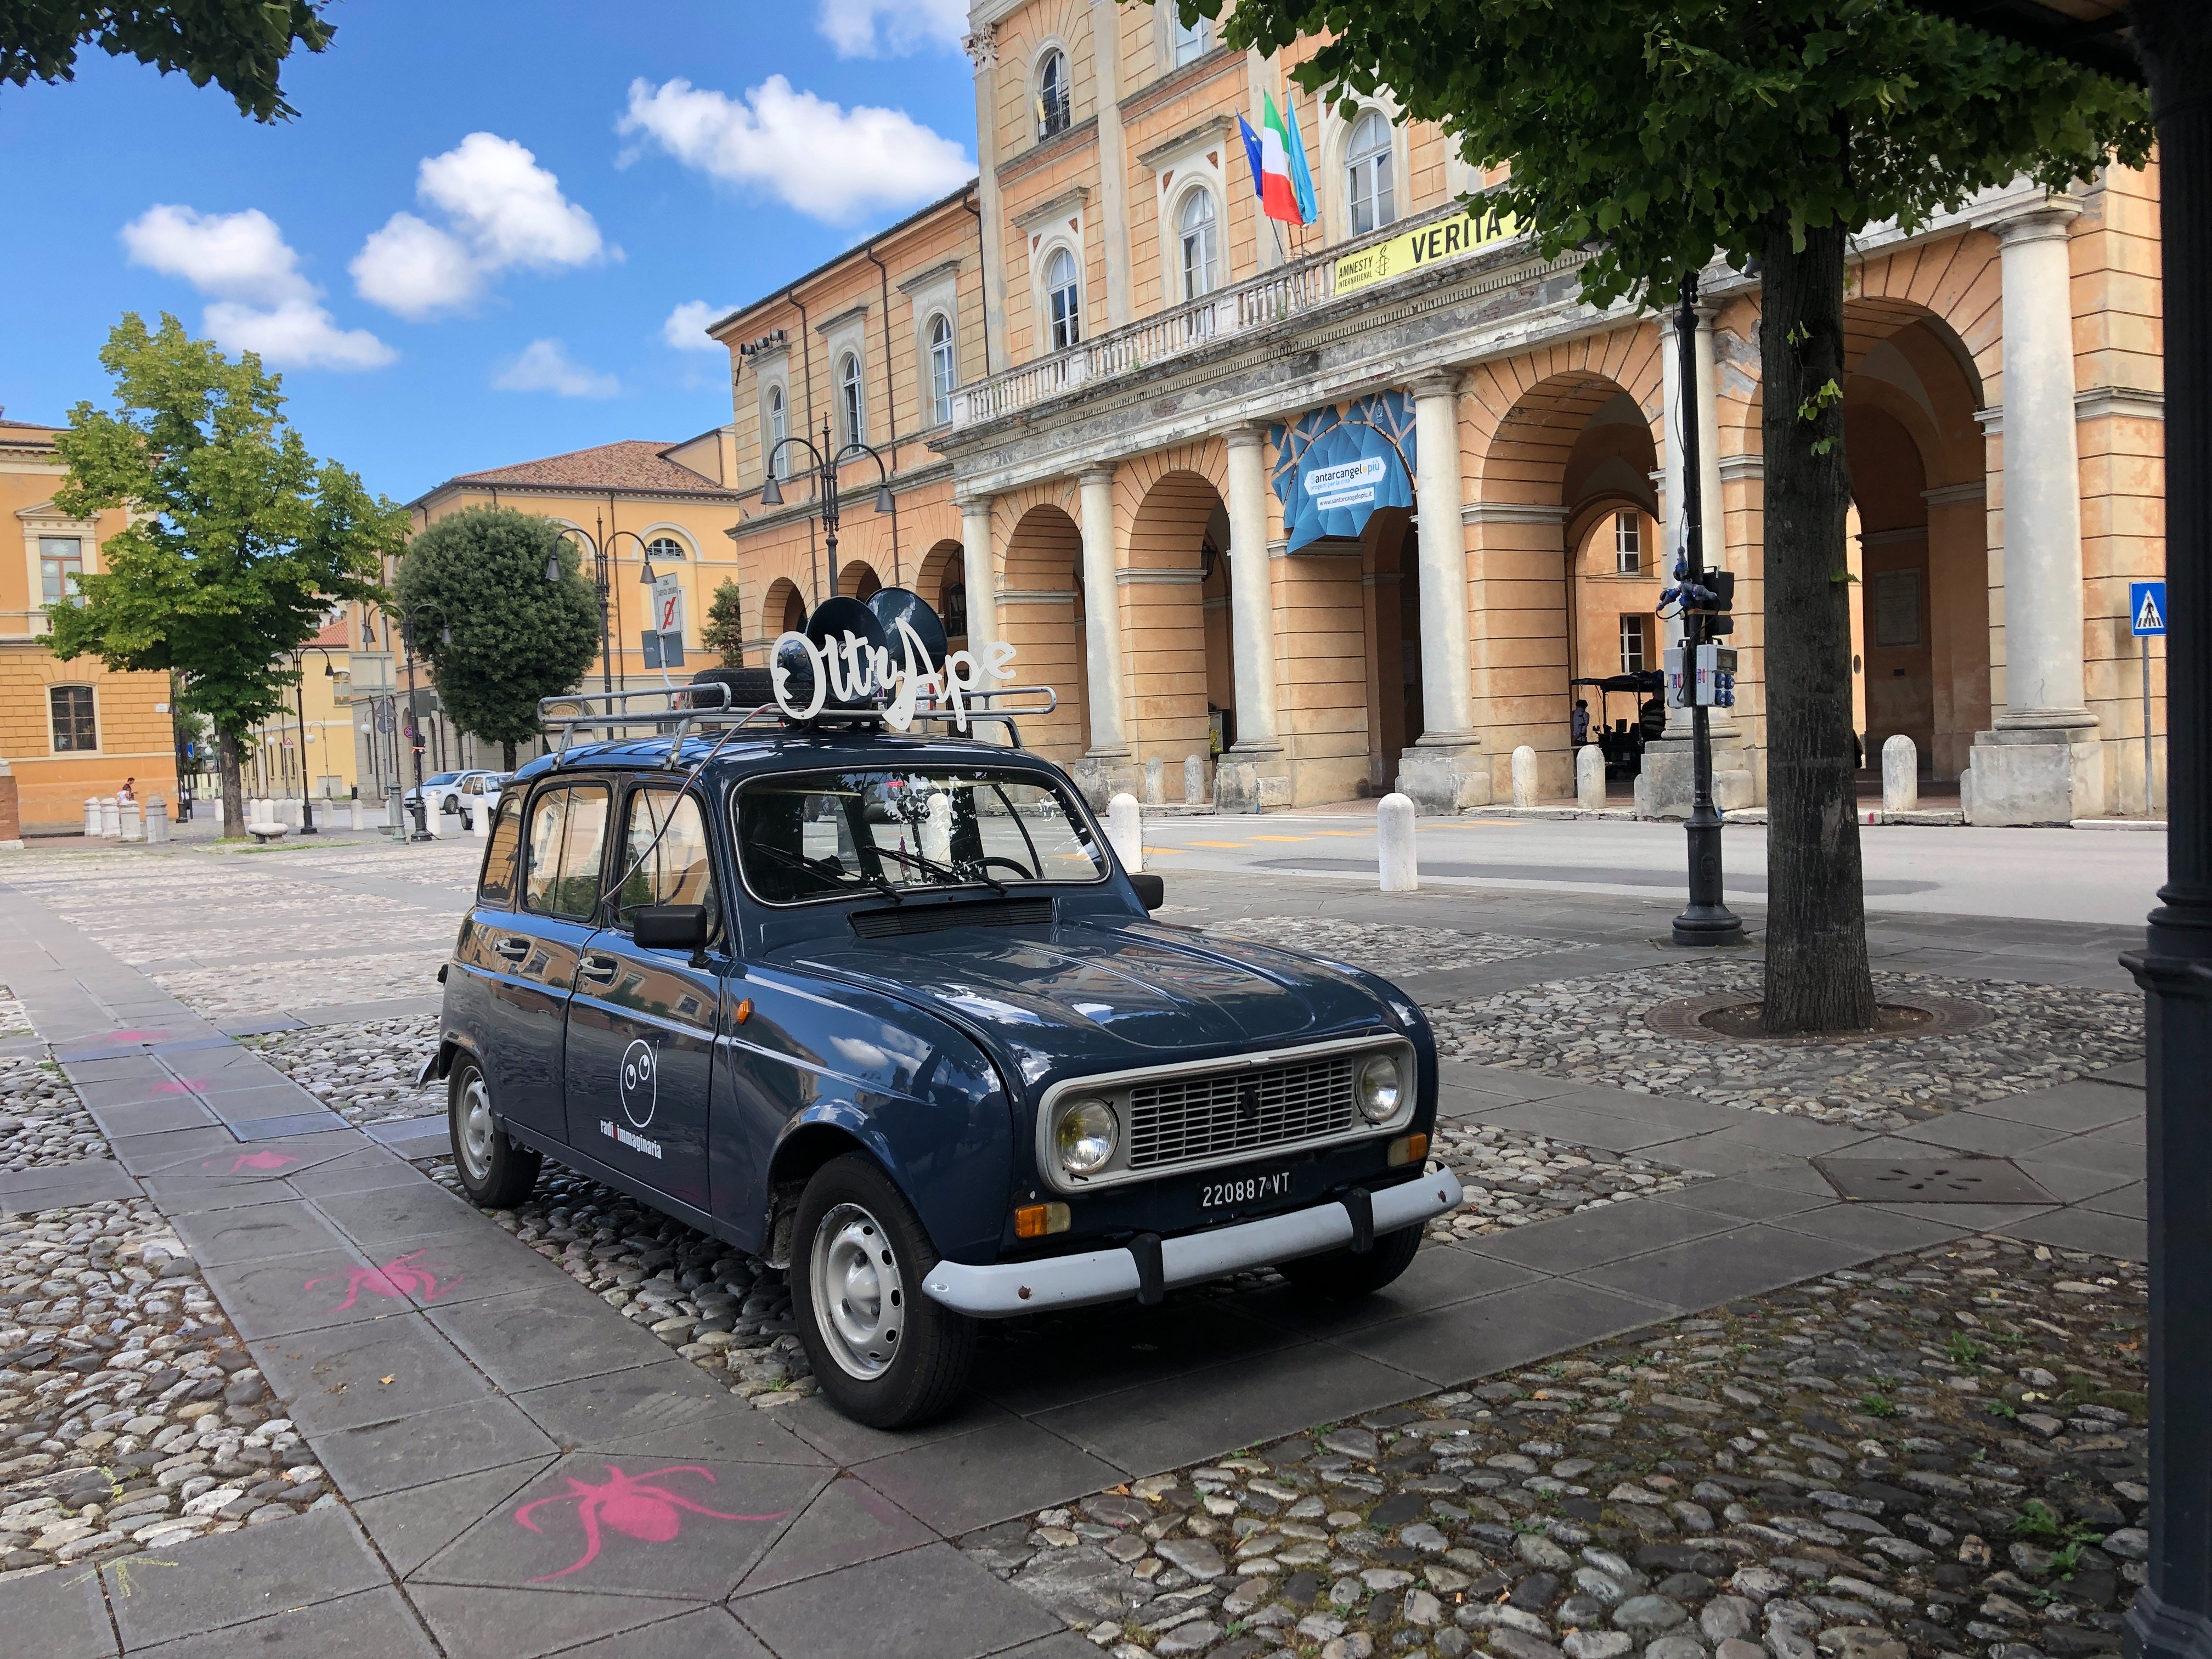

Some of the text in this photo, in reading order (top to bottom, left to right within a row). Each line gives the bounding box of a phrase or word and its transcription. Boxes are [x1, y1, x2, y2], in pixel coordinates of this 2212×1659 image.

[1339, 256, 1373, 279] AMNESTY
[1338, 270, 1373, 289] INTERNATIONAL
[1203, 1172, 1289, 1207] 220887 VT
